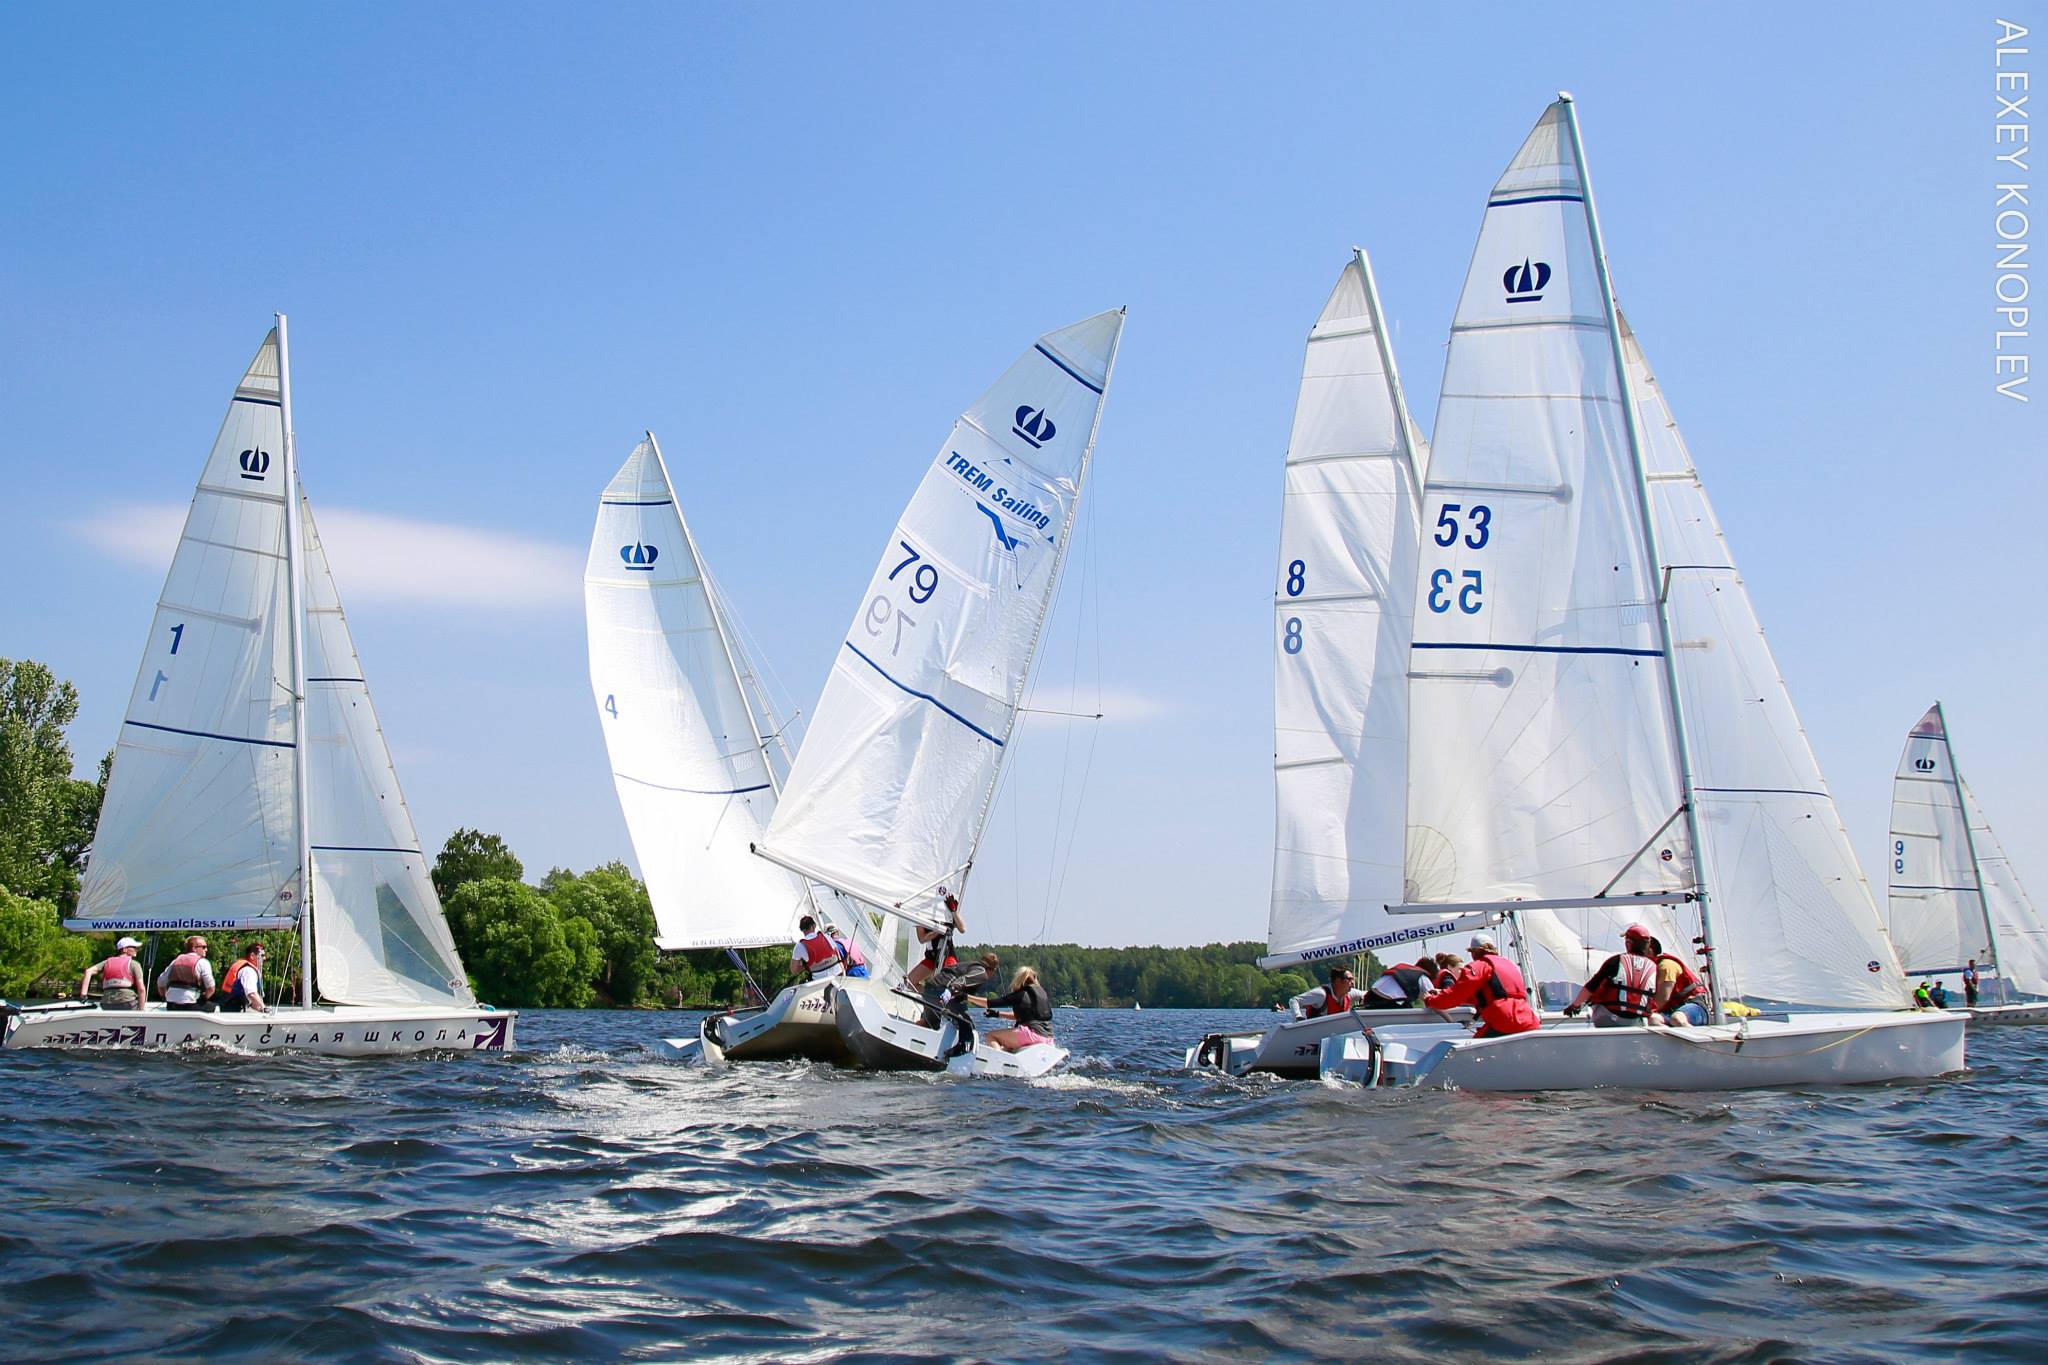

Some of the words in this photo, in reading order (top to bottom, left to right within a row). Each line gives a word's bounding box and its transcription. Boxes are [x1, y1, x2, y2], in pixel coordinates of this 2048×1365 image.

[945, 451, 993, 492] TREM
[991, 487, 1051, 530] Sailing
[1434, 504, 1491, 549] 53
[888, 541, 939, 604] 79
[1286, 559, 1305, 596] 8
[170, 623, 184, 655] 1
[1283, 617, 1302, 654] 8
[605, 694, 618, 719] 4
[1894, 840, 1904, 856] 9
[92, 918, 235, 930] www.nationalclass.ru
[1300, 921, 1455, 961] www.nationalclass.ru
[155, 1032, 344, 1045] ПАРУСНАЯ
[364, 1029, 467, 1042] ШКОЛА
